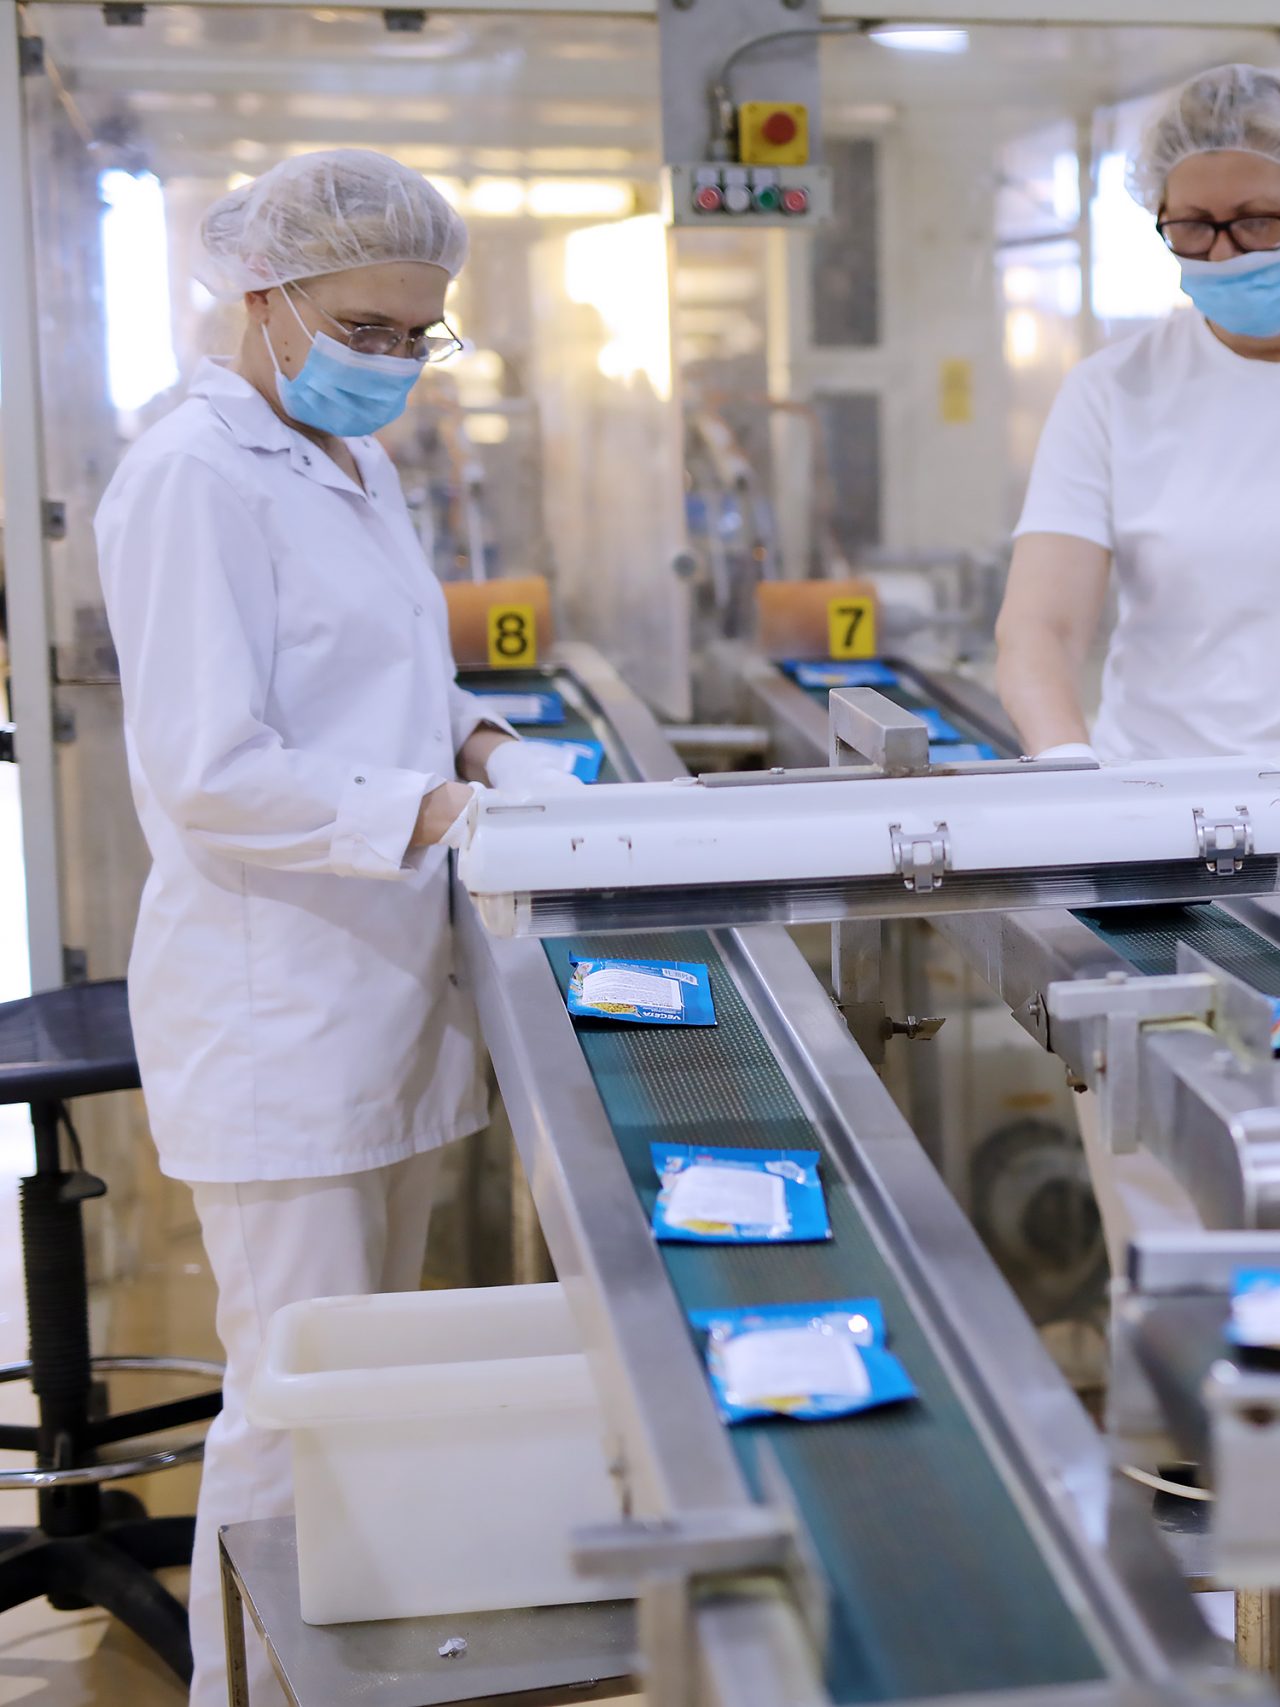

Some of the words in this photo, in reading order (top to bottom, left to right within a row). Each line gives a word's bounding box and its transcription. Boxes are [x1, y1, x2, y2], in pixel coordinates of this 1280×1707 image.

[496, 612, 527, 657] 8
[836, 606, 864, 648] 7
[643, 1011, 681, 1020] VEGETA
